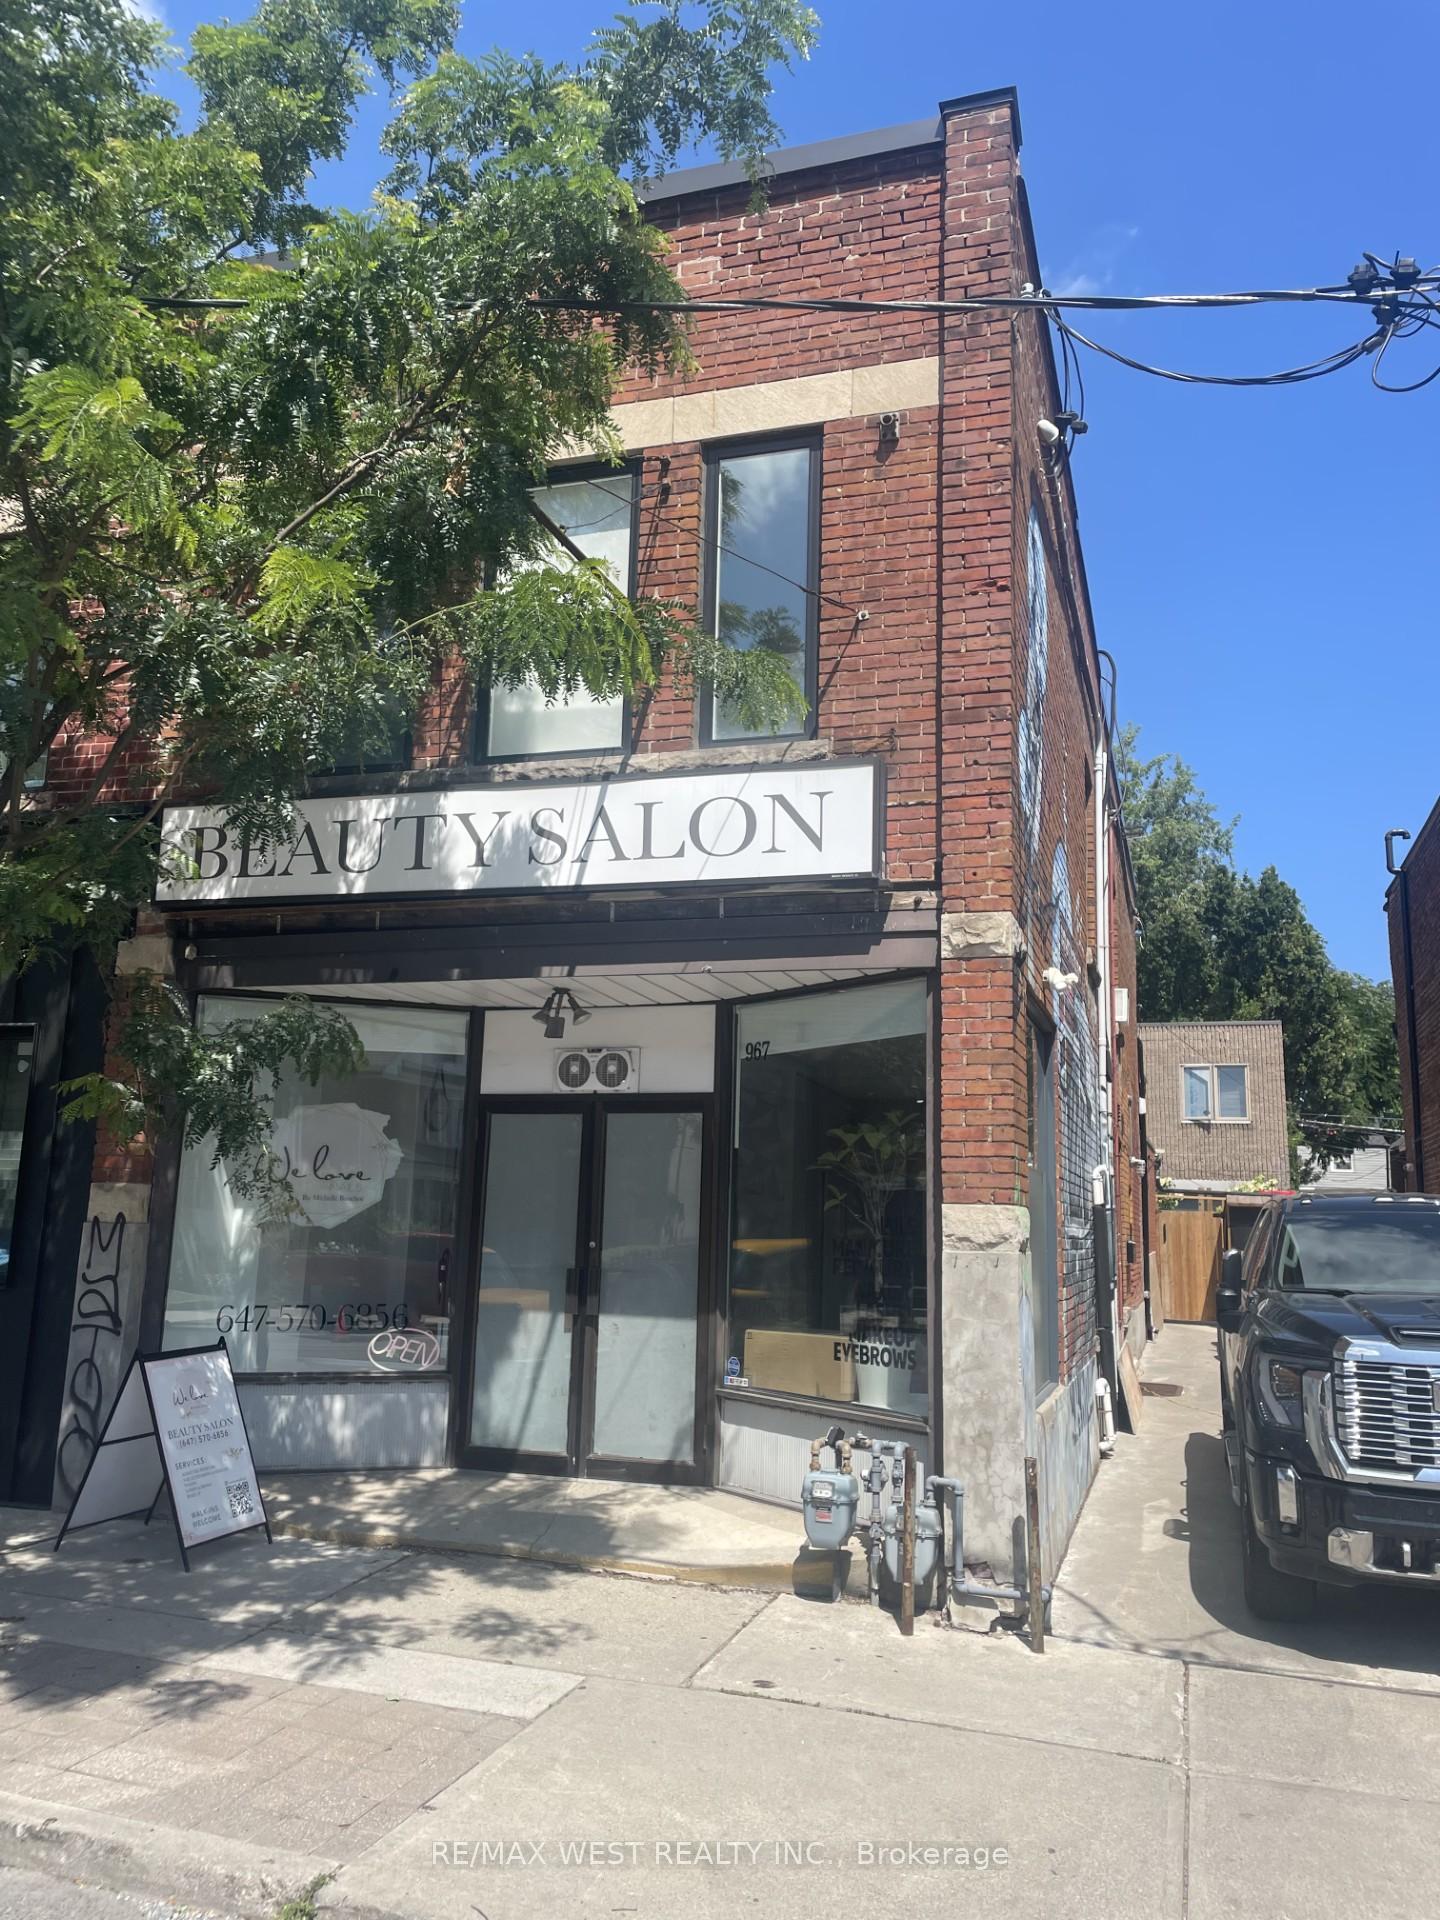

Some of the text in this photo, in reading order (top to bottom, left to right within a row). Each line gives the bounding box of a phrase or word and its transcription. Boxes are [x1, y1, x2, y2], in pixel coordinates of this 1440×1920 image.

[186, 790, 834, 881] BEAUTY SALON
[746, 1041, 770, 1062] 967
[312, 1144, 371, 1181] love
[216, 1304, 409, 1333] 647-570-6856
[371, 1332, 438, 1368] OPEN
[833, 1341, 917, 1370] EYEBROWS
[167, 1417, 234, 1440] BEAUTY SALON
